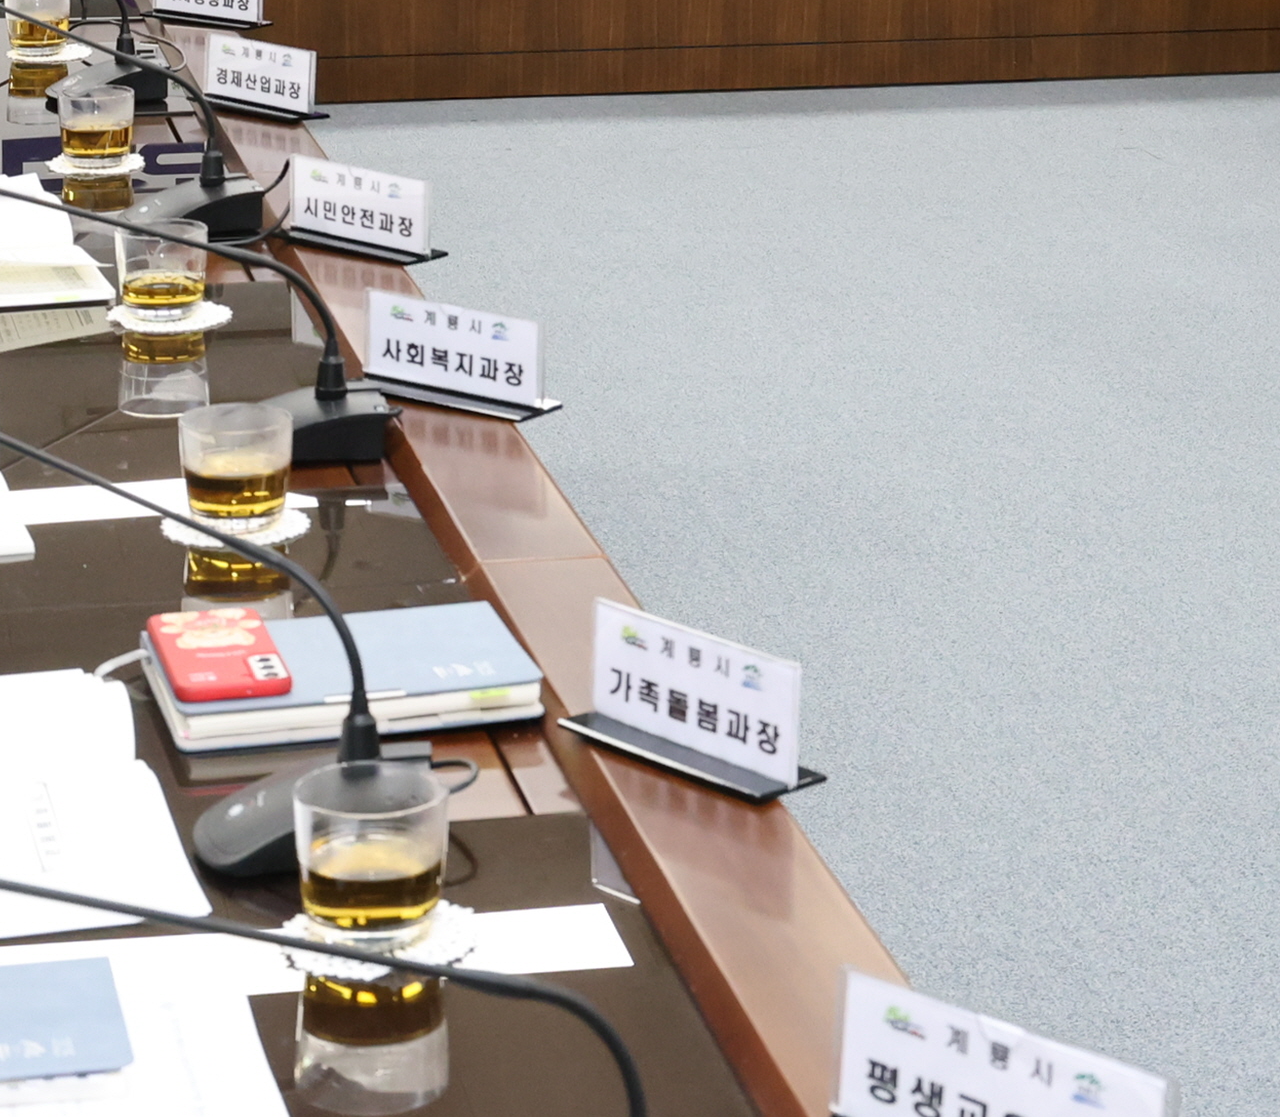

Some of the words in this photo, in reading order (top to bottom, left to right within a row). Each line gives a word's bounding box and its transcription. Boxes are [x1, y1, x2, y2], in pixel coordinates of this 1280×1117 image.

[215, 66, 302, 100] 경제산업과장
[303, 196, 414, 238] 시민안전과장
[382, 337, 525, 388] 사회복지과장
[608, 666, 782, 757] 가족돌봄과장
[866, 1058, 1030, 1117] 평생교
